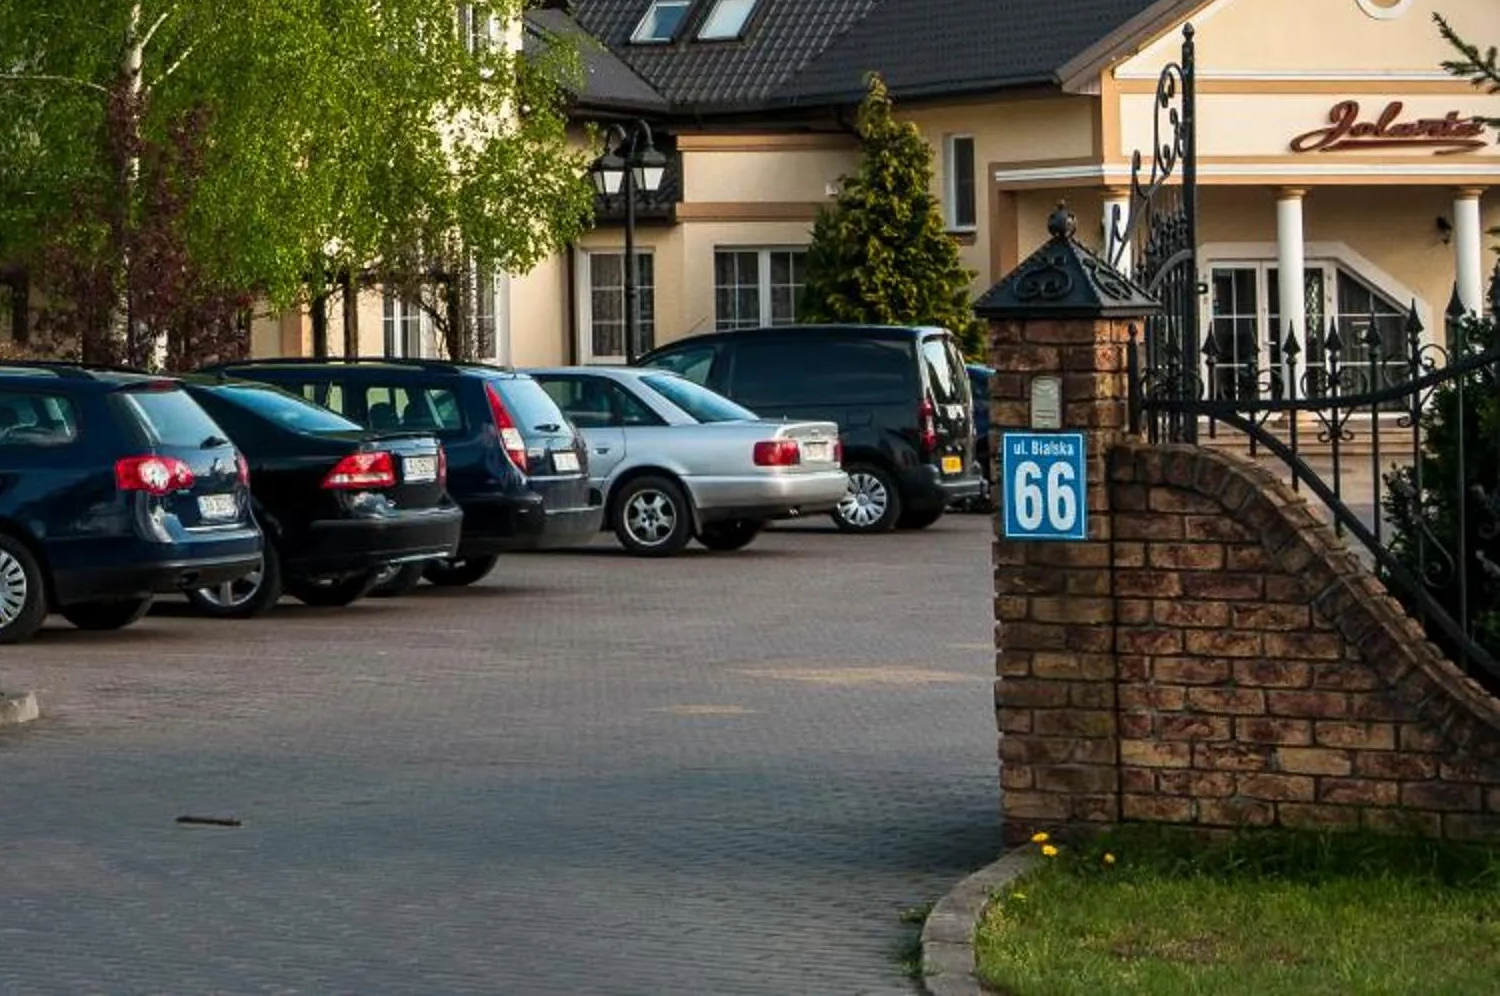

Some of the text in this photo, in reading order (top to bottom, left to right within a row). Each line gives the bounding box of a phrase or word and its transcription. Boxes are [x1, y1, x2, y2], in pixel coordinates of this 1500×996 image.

[1289, 99, 1485, 153] Jolanta
[1013, 439, 1029, 455] ul.
[1014, 460, 1077, 531] 66
